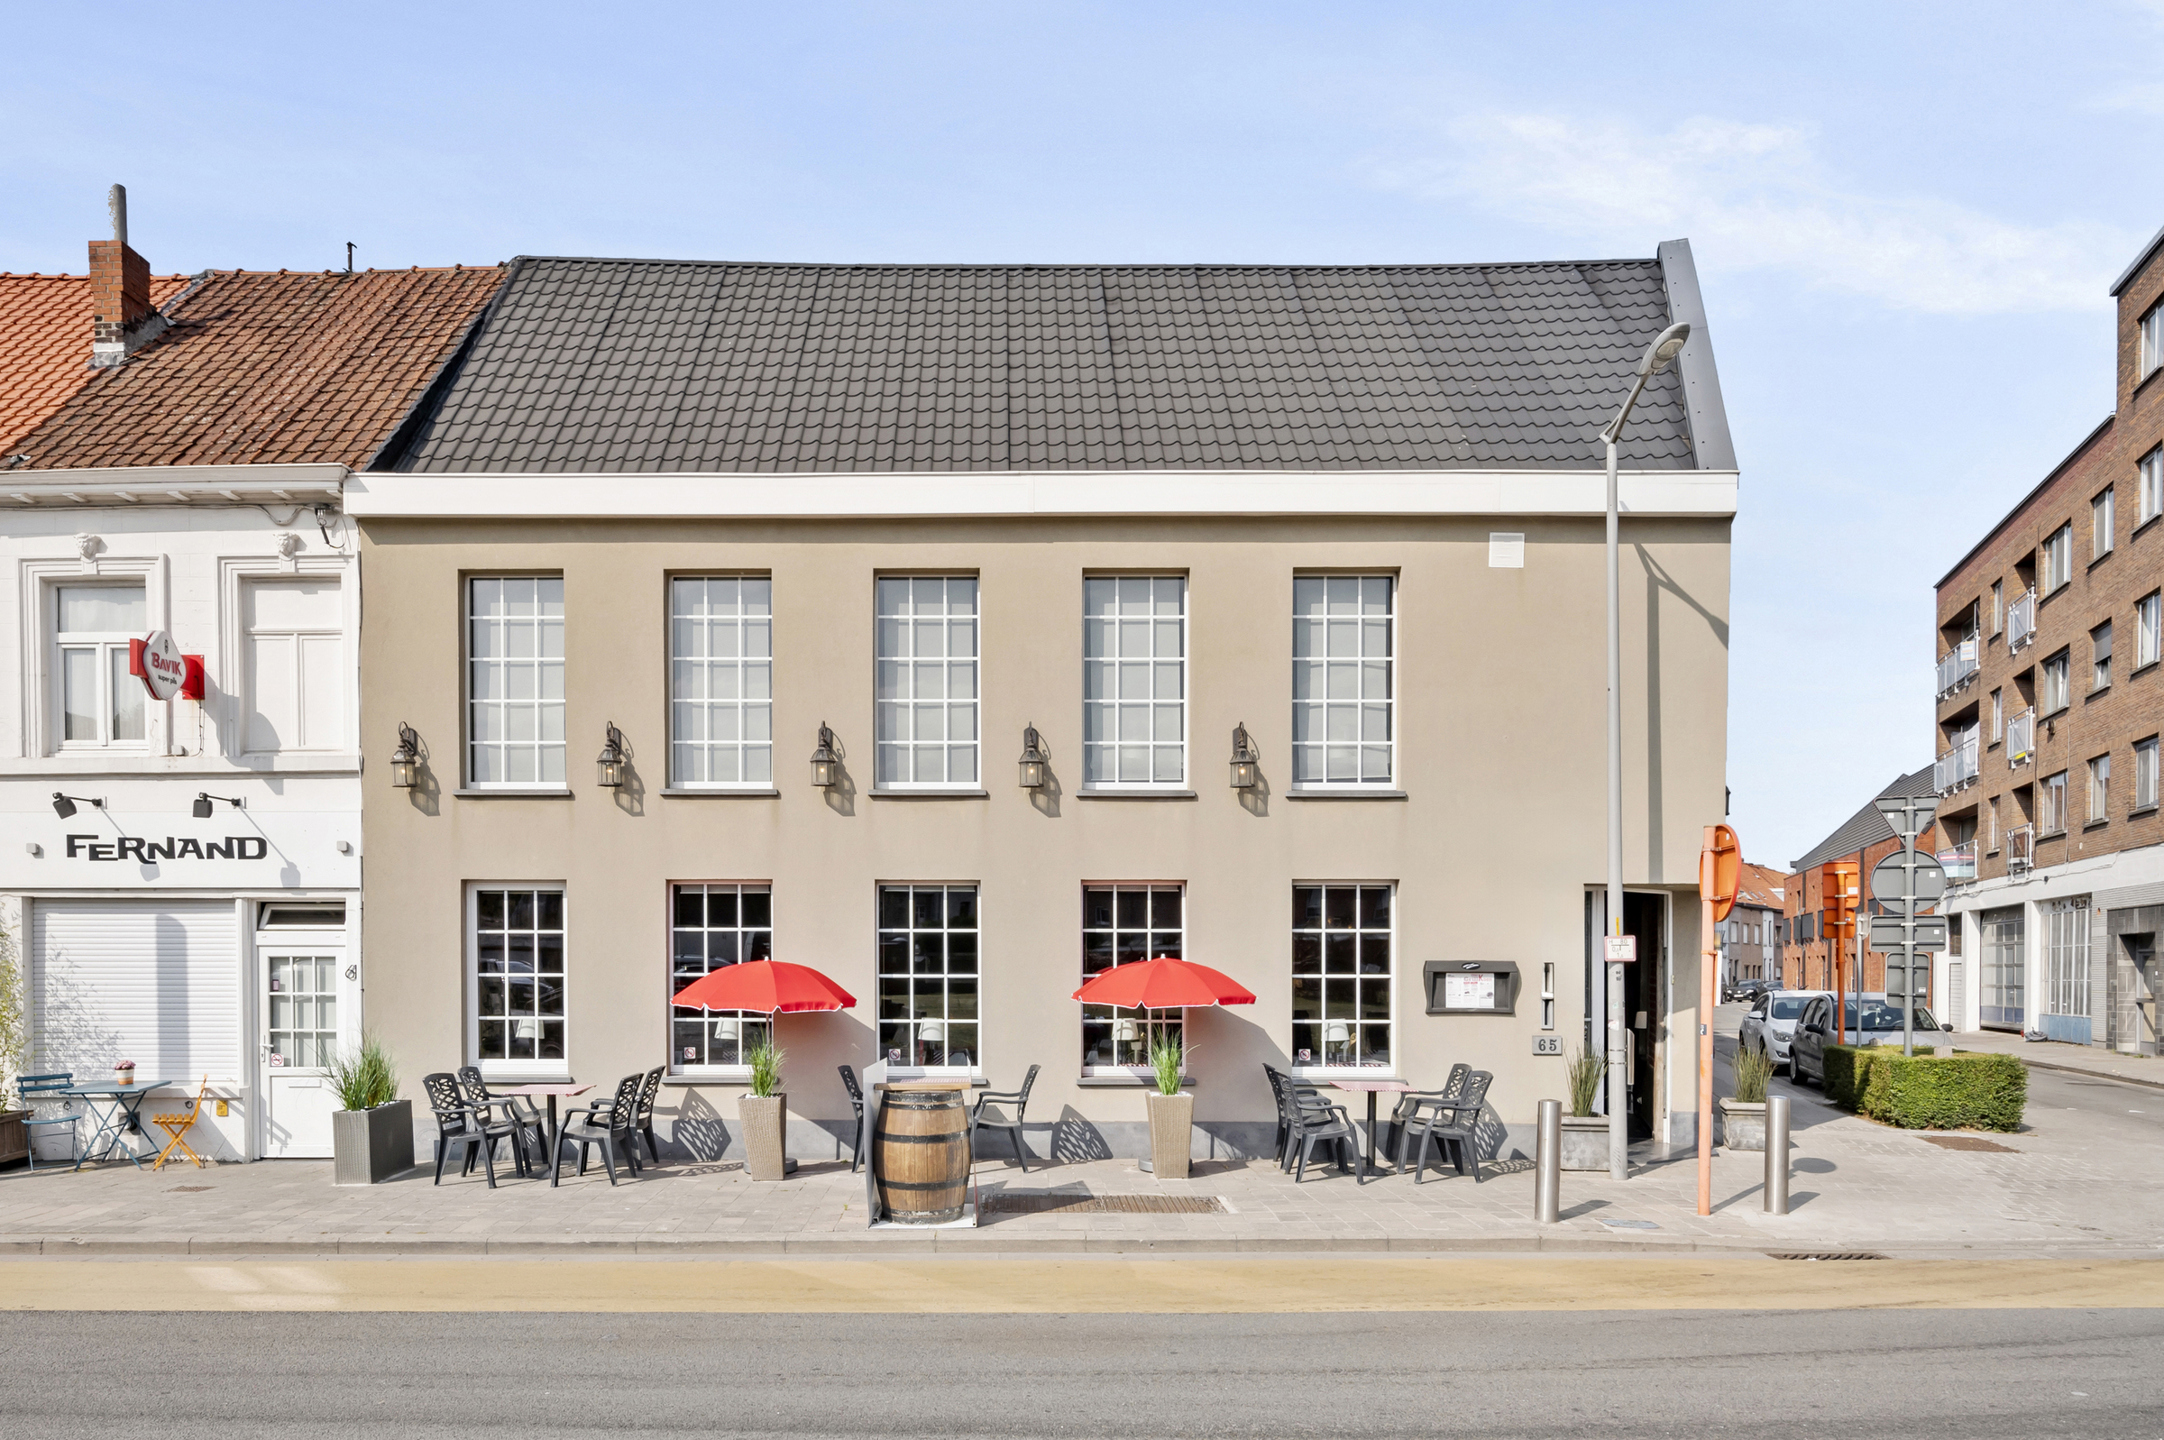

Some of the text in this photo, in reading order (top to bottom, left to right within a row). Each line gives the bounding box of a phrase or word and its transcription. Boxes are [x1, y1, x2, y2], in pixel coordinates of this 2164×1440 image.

[151, 652, 182, 677] BAVIK
[158, 674, 178, 685] super pils
[66, 834, 268, 864] FERNAND
[1538, 1038, 1557, 1052] 65
